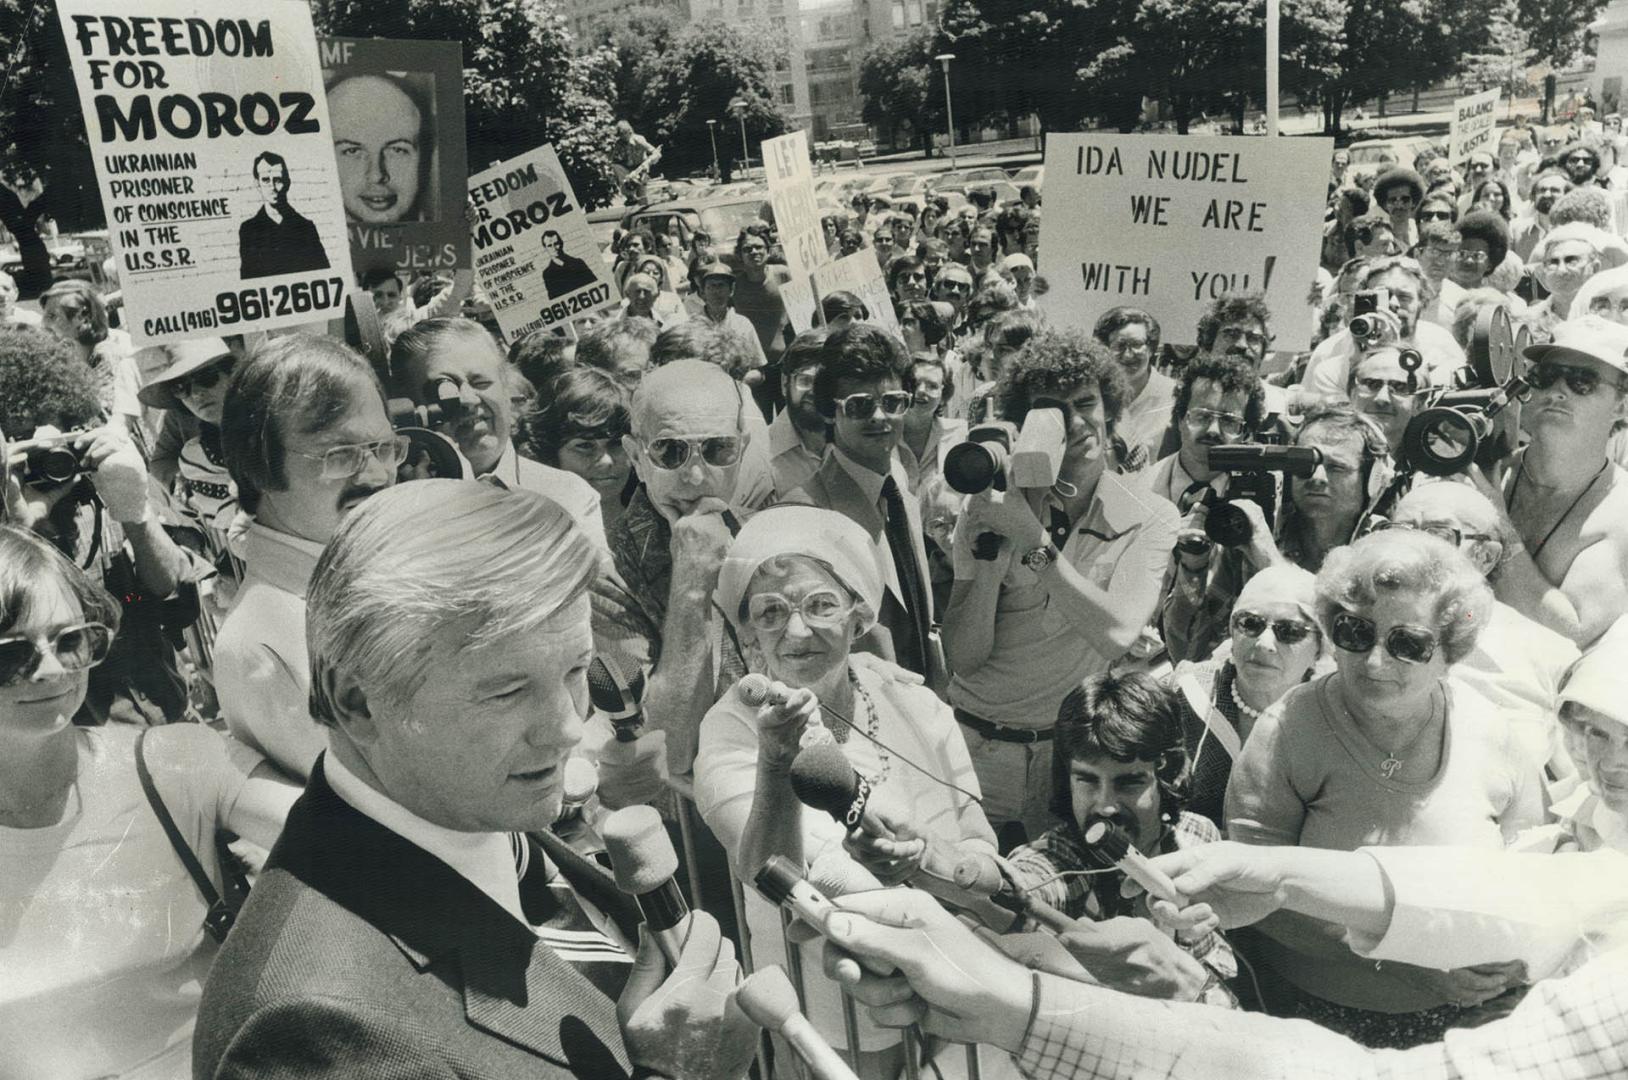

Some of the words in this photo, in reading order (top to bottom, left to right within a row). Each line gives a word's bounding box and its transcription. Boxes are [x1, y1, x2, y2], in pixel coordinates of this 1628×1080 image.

[71, 15, 273, 57] FREEDOM
[87, 60, 169, 90] FOR
[95, 92, 320, 142] MOROZ
[105, 152, 197, 174] UKRAINIAN
[773, 138, 800, 178] LET
[1077, 146, 1123, 175] IDA
[1148, 150, 1248, 183] NUDEL
[110, 176, 194, 199] PRISONER
[113, 205, 133, 223] OF
[138, 198, 231, 223] CONSCIENCE
[1131, 195, 1171, 226] WE
[1202, 199, 1267, 232] ARE
[120, 229, 139, 248] IN
[144, 226, 181, 245] THE
[125, 248, 196, 271] U.S.S.R.
[478, 257, 516, 279] PRISONER
[501, 283, 517, 296] THE
[1082, 262, 1151, 295] WITH
